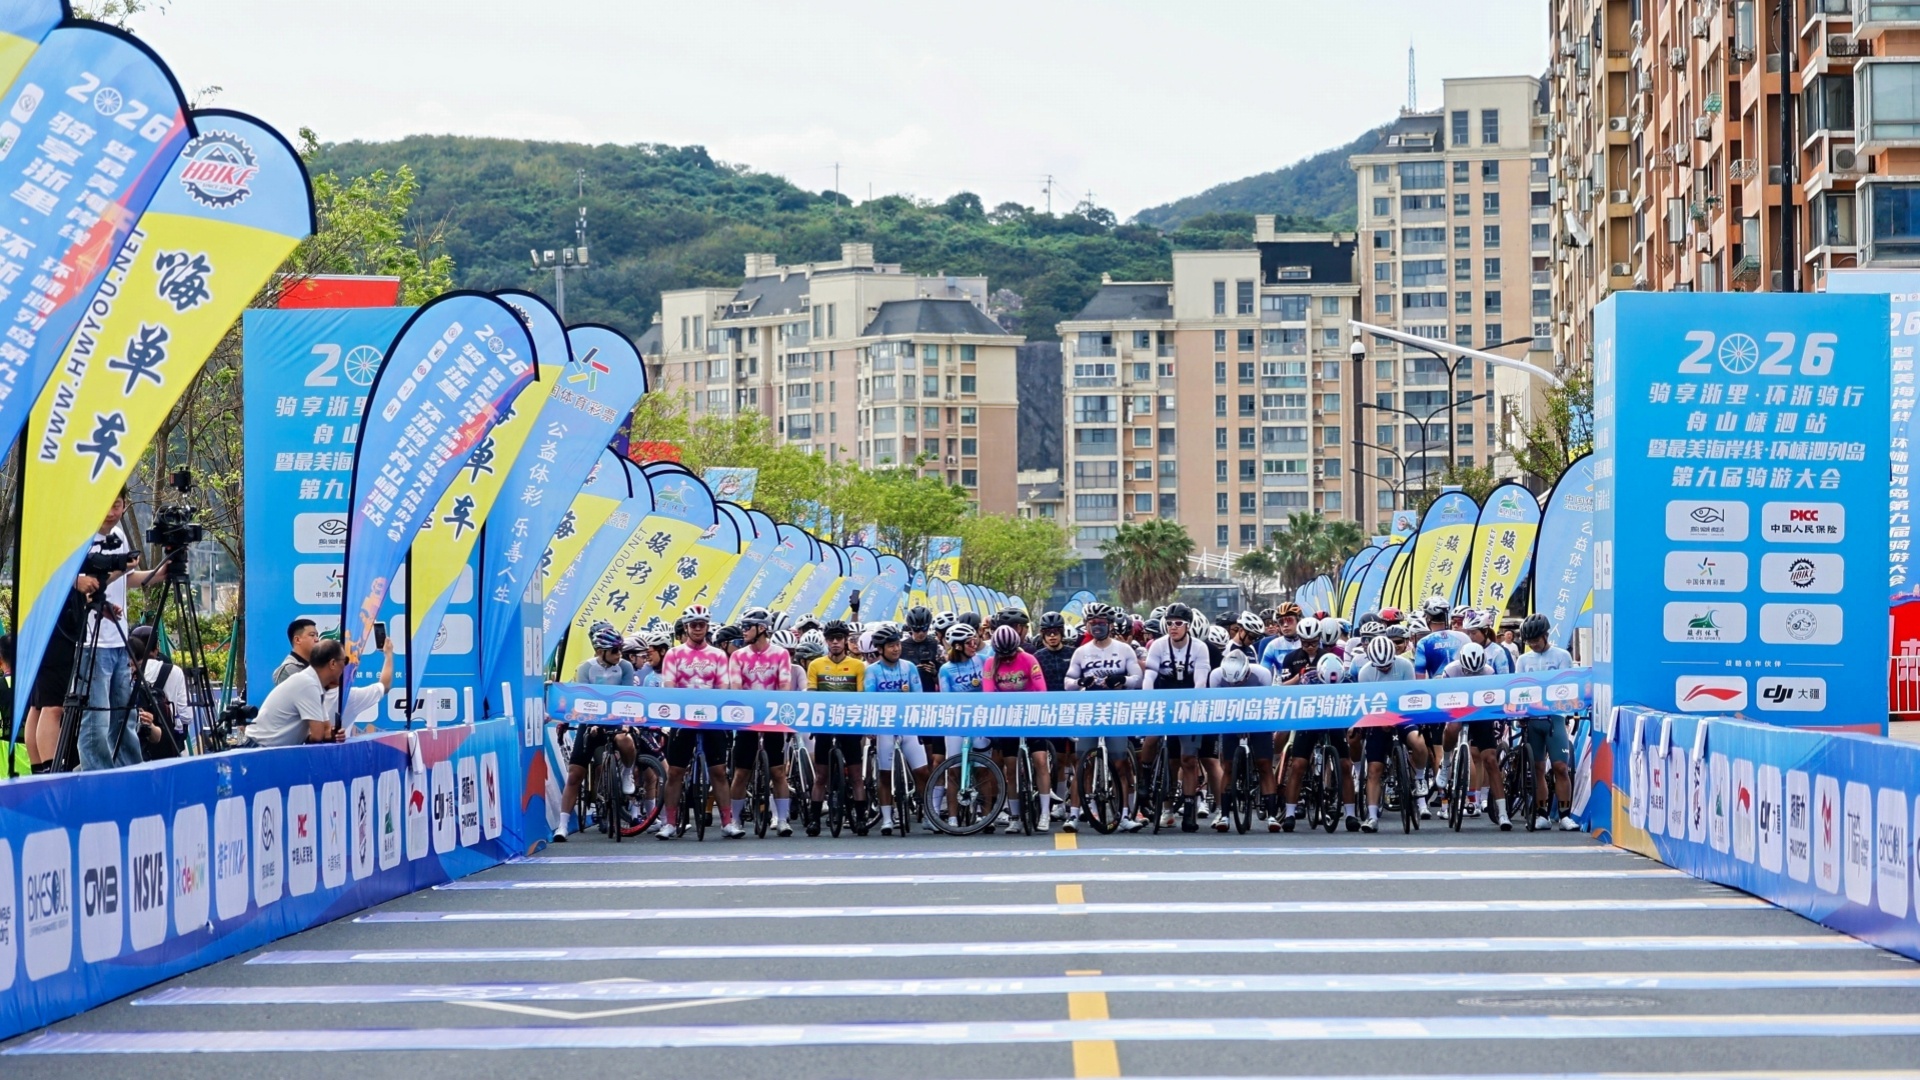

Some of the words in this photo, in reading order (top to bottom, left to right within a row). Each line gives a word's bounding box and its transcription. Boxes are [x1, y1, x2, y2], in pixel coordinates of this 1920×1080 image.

[181, 161, 257, 187] HBIKE
[40, 227, 146, 462] WWW.HWYOU.NET
[1678, 330, 1838, 376] 2026
[1648, 383, 1865, 407] 骑享浙里·环浙骑行
[1686, 411, 1827, 434] 舟山嵊泗站
[1646, 439, 1865, 462] 暨最美海岸线·环嵊泗列岛
[298, 478, 351, 499] 第九
[1672, 466, 1841, 490] 第九届骑游大会
[1790, 509, 1818, 521] PICC
[1771, 524, 1837, 534] 中国人民保险
[576, 526, 648, 627] WWW.HWYOU.NET
[593, 532, 671, 622] 骏彩体
[1797, 688, 1820, 699] 大疆
[134, 852, 164, 912] NSVE
